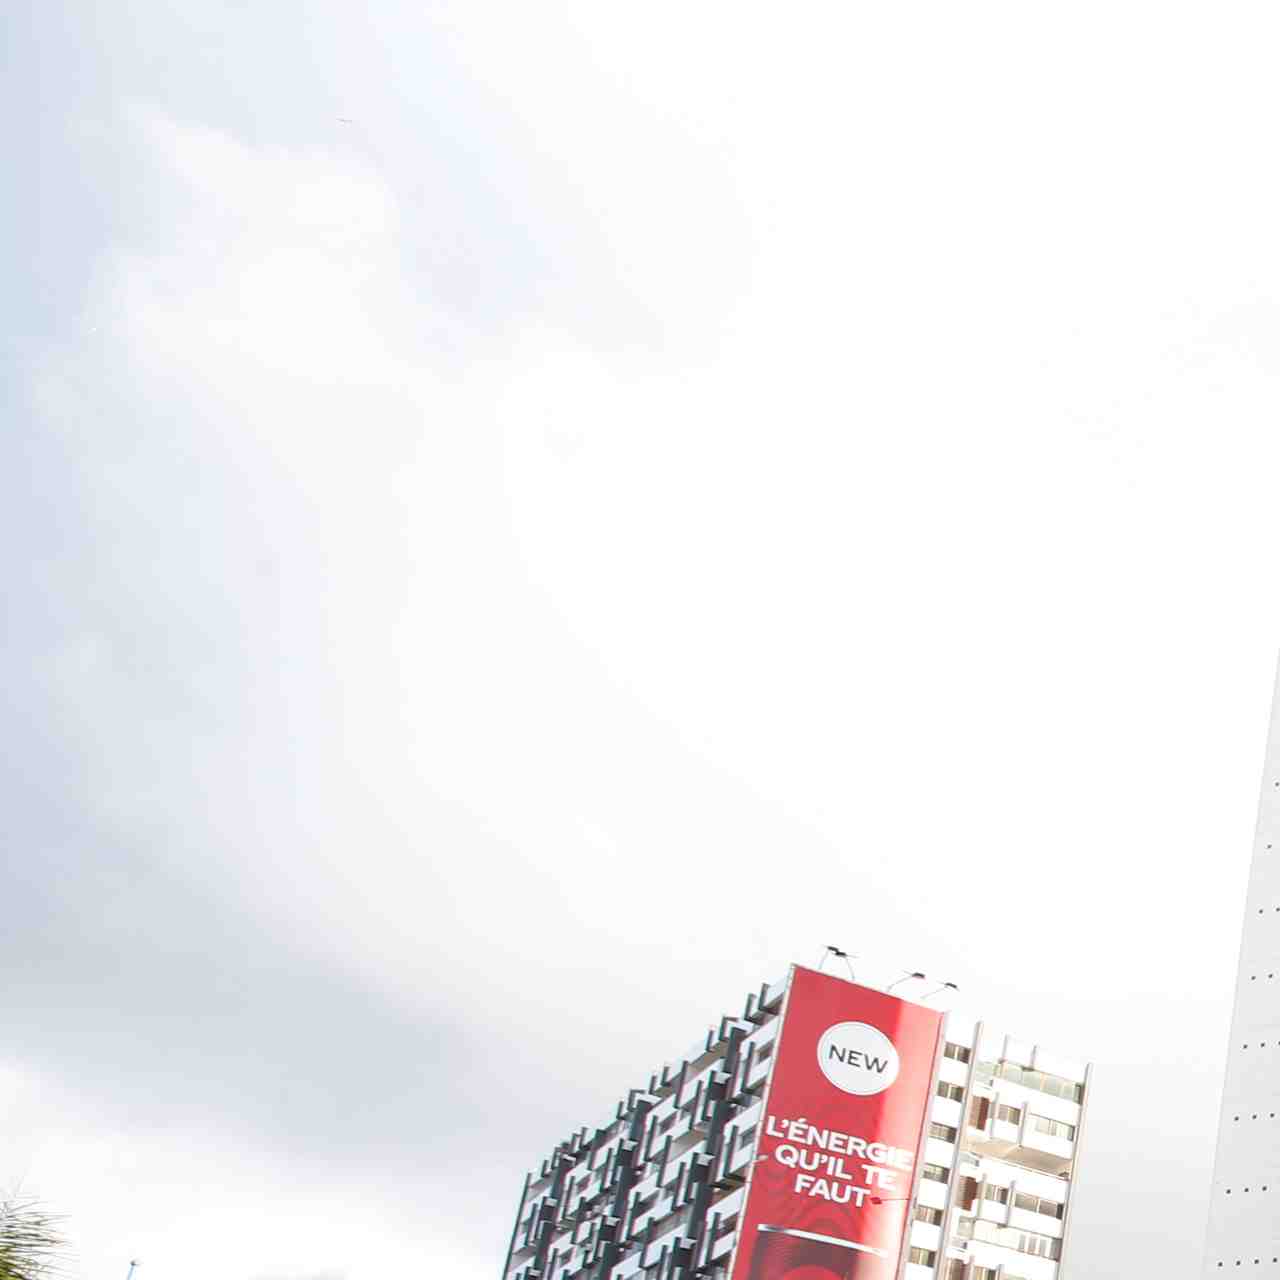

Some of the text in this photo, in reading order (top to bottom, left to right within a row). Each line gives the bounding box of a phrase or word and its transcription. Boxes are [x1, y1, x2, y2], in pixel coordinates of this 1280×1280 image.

[829, 1044, 888, 1073] NEW
[775, 1144, 897, 1192] QU'IL TE
[794, 1173, 871, 1207] FAUT
